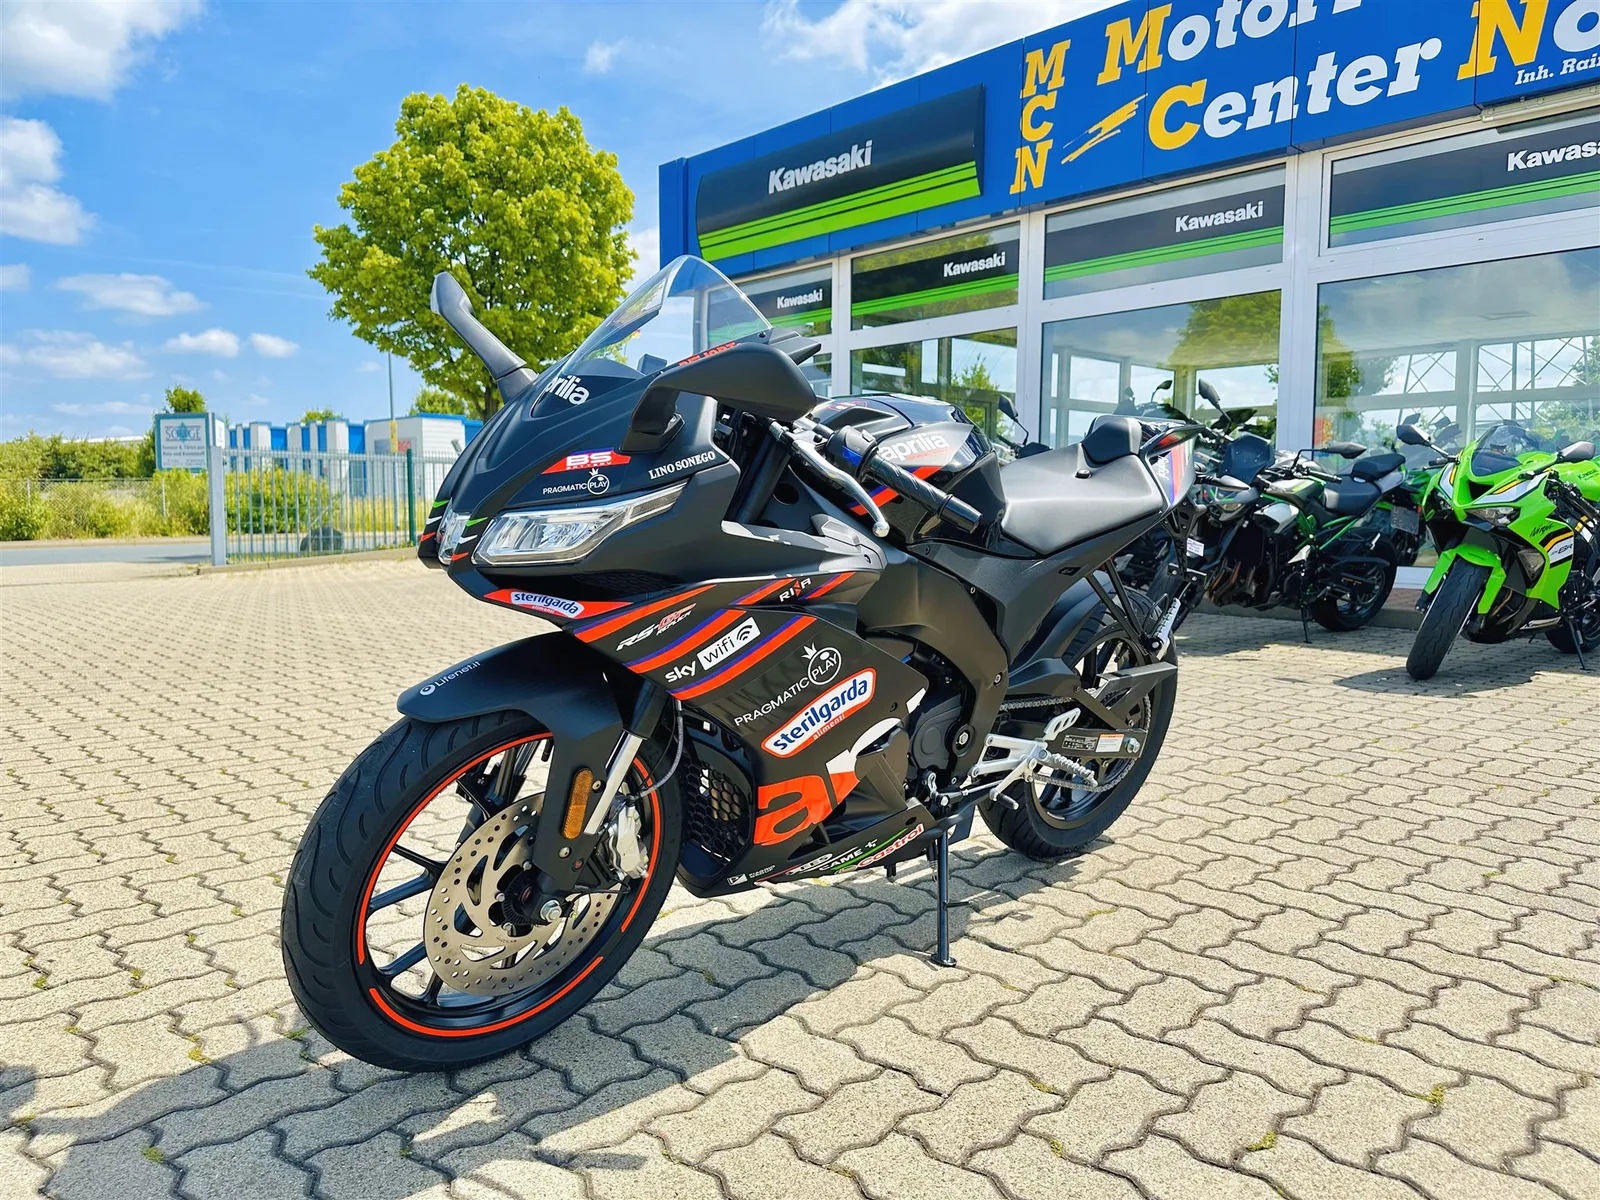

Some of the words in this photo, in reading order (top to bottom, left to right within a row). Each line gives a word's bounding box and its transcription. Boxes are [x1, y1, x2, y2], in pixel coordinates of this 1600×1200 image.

[1514, 65, 1554, 86] Inh.
[1148, 37, 1442, 150] Center
[768, 140, 874, 194] Kawasaki
[1175, 201, 1264, 233] Kawasaki
[943, 251, 1006, 278] Kawasaki
[776, 289, 823, 309] Kawasaki
[566, 451, 612, 467] BS
[879, 432, 950, 462] aprilia
[648, 463, 676, 480] LINO
[675, 450, 716, 471] SONEGO
[542, 482, 588, 495] PRAGMATIC
[589, 480, 608, 489] PLAY
[514, 592, 579, 614] sterilgarda
[664, 660, 697, 684] sky
[702, 635, 736, 665] wifi
[734, 676, 811, 727] PRAGMATIC
[811, 653, 839, 679] PLAY
[773, 678, 868, 751] sterilgarda
[812, 712, 846, 741] alimenti
[857, 823, 925, 868] Castrol
